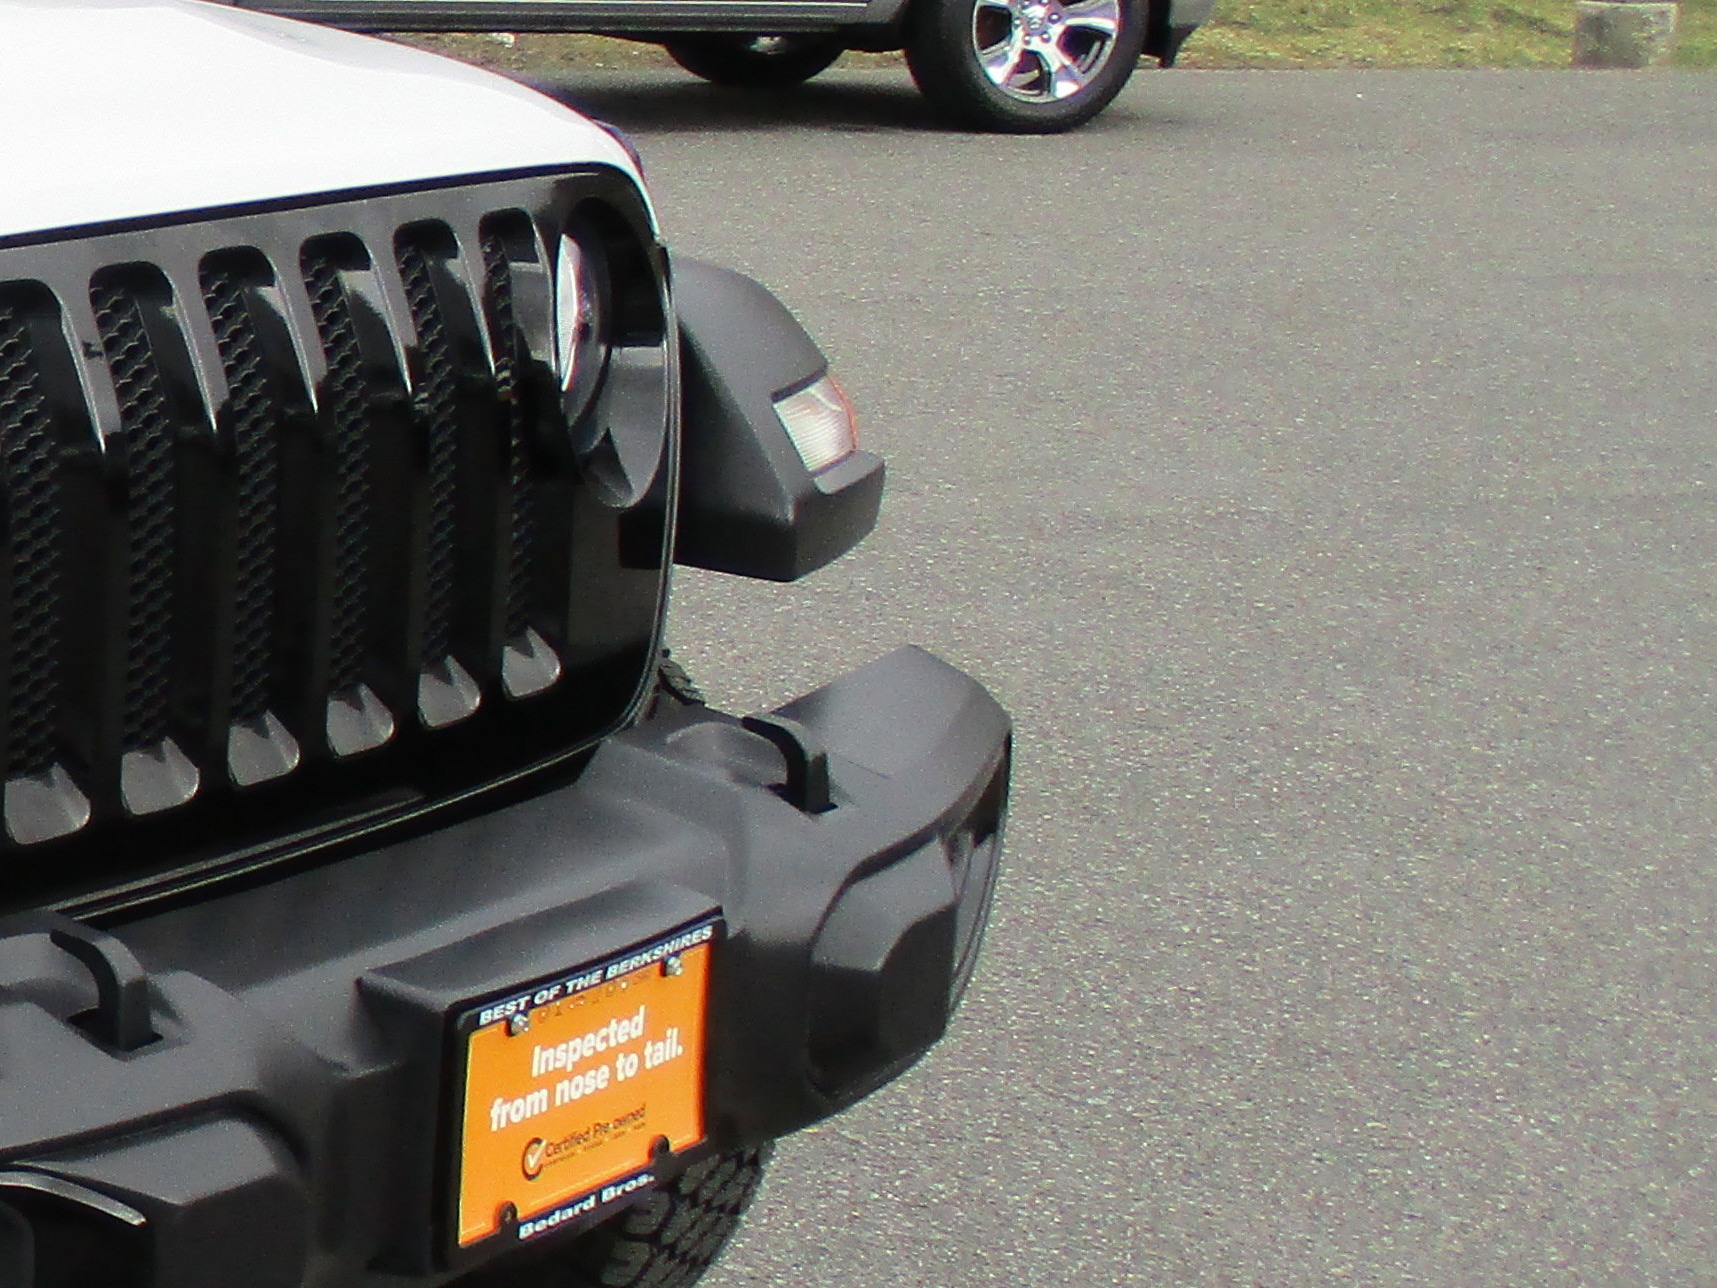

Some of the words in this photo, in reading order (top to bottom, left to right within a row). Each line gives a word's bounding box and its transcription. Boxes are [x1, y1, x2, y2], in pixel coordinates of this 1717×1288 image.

[479, 996, 531, 1026] BEST
[534, 984, 562, 1005] OF
[566, 970, 604, 994] THE
[606, 925, 713, 980] BERKSHIRES
[531, 1005, 646, 1078] Inspected
[490, 1088, 549, 1132] from
[555, 1064, 610, 1107] nose
[616, 1053, 639, 1082] to
[644, 1027, 684, 1070] tail.
[545, 1126, 591, 1157] Certified
[518, 1195, 597, 1240] Bedard
[601, 1173, 655, 1204] Bros.
